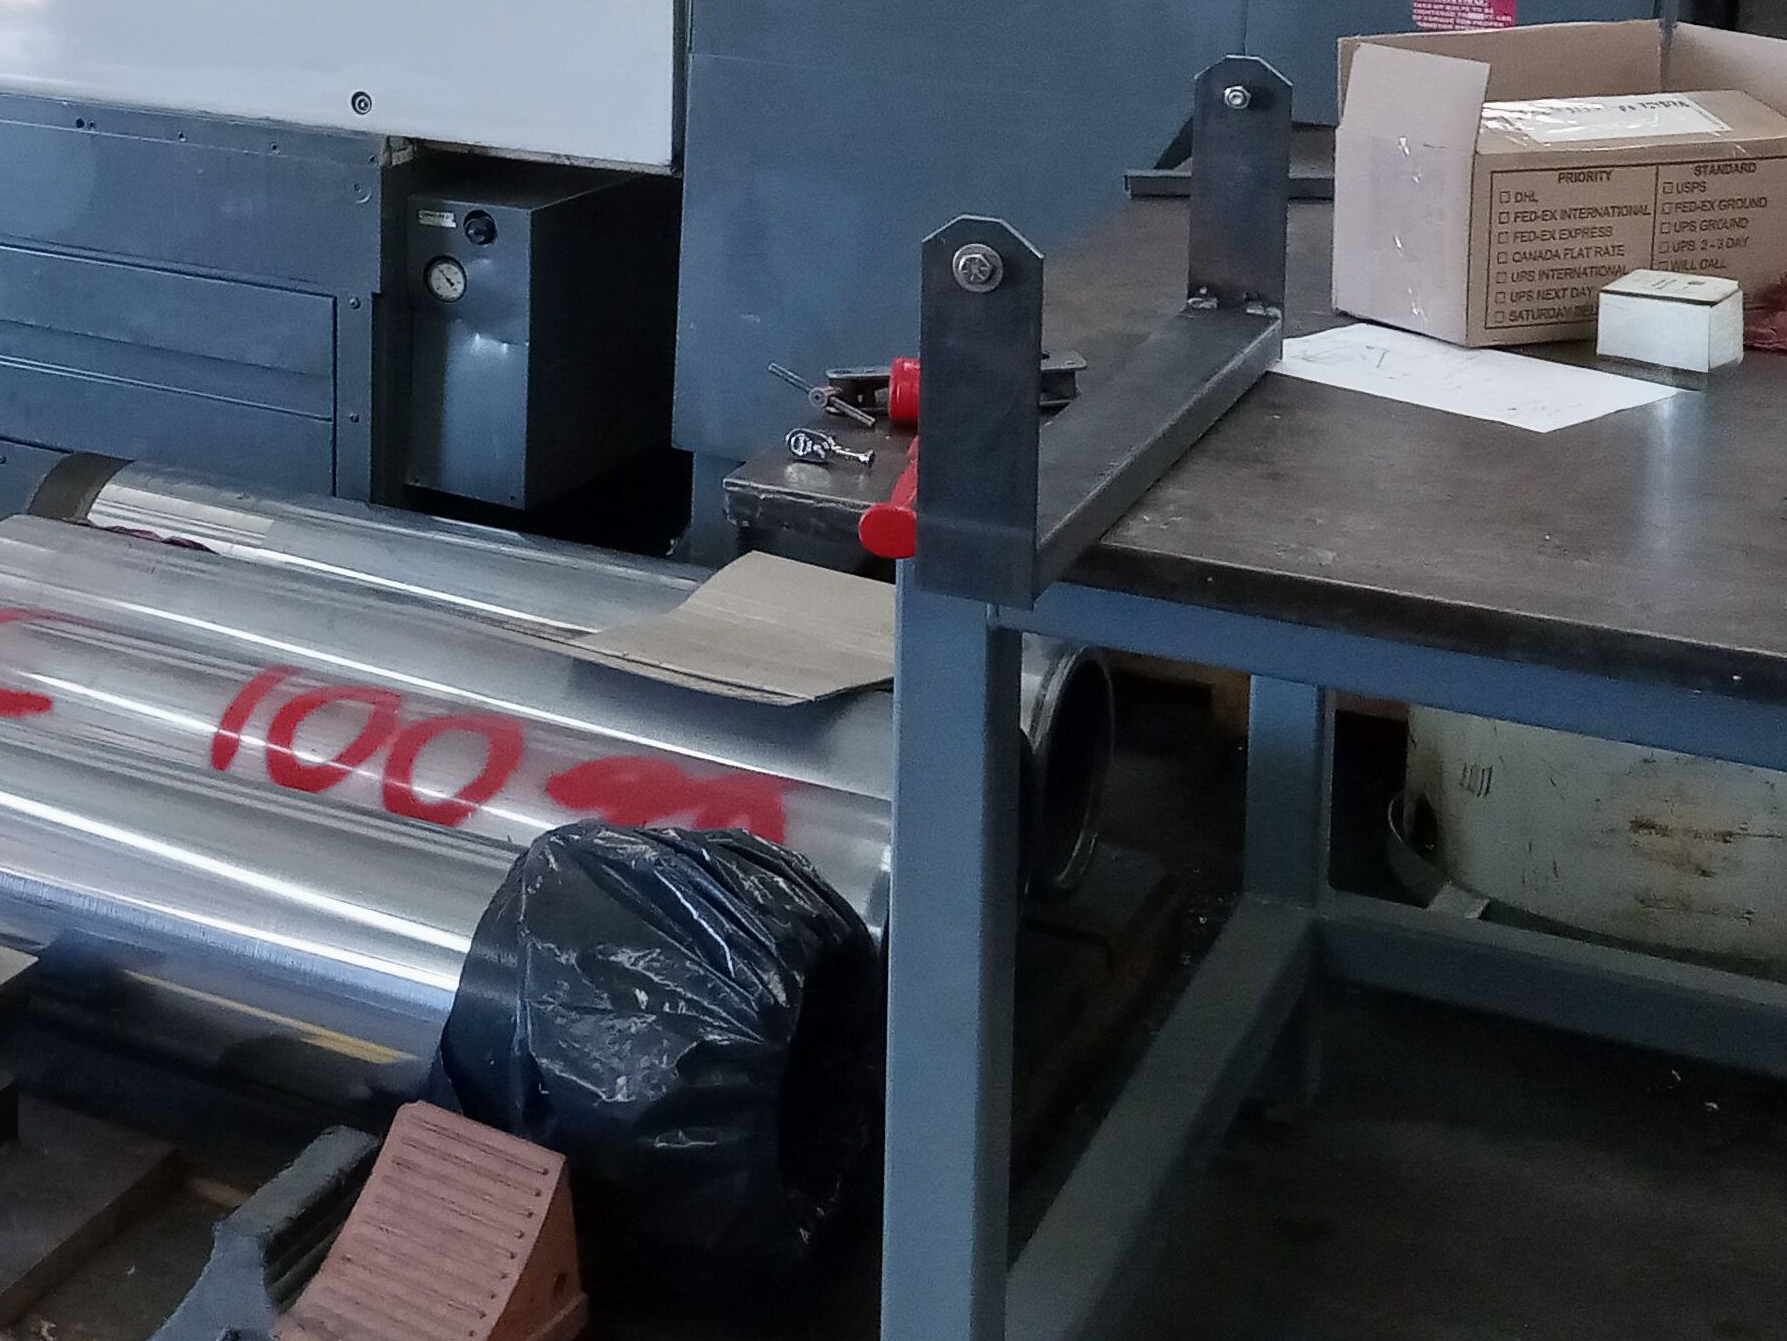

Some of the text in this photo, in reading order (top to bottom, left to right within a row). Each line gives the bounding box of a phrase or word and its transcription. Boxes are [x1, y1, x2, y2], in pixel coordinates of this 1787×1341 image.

[1557, 170, 1613, 184] PRIORITY
[1693, 162, 1757, 176] STANDARD
[1676, 181, 1707, 194] USPS
[1514, 191, 1539, 203] DHL
[1674, 196, 1768, 213] FED-EX GROUND
[1513, 205, 1652, 223] FED-EX INTERNATIONAL
[1674, 217, 1749, 233] UPS GROUND
[1513, 226, 1613, 243] FED-EX EXPRESS
[1672, 240, 1696, 253] UPS
[1726, 236, 1749, 249] DAY
[1512, 244, 1625, 263] CANADA FLAT RATE
[1511, 264, 1628, 283] UPS INTERNATIONAL
[1670, 258, 1727, 272] WILL CALL
[1510, 286, 1595, 303] UPS NEXT DAY
[1508, 307, 1569, 322] SATURDAY
[210, 664, 526, 826] 100
